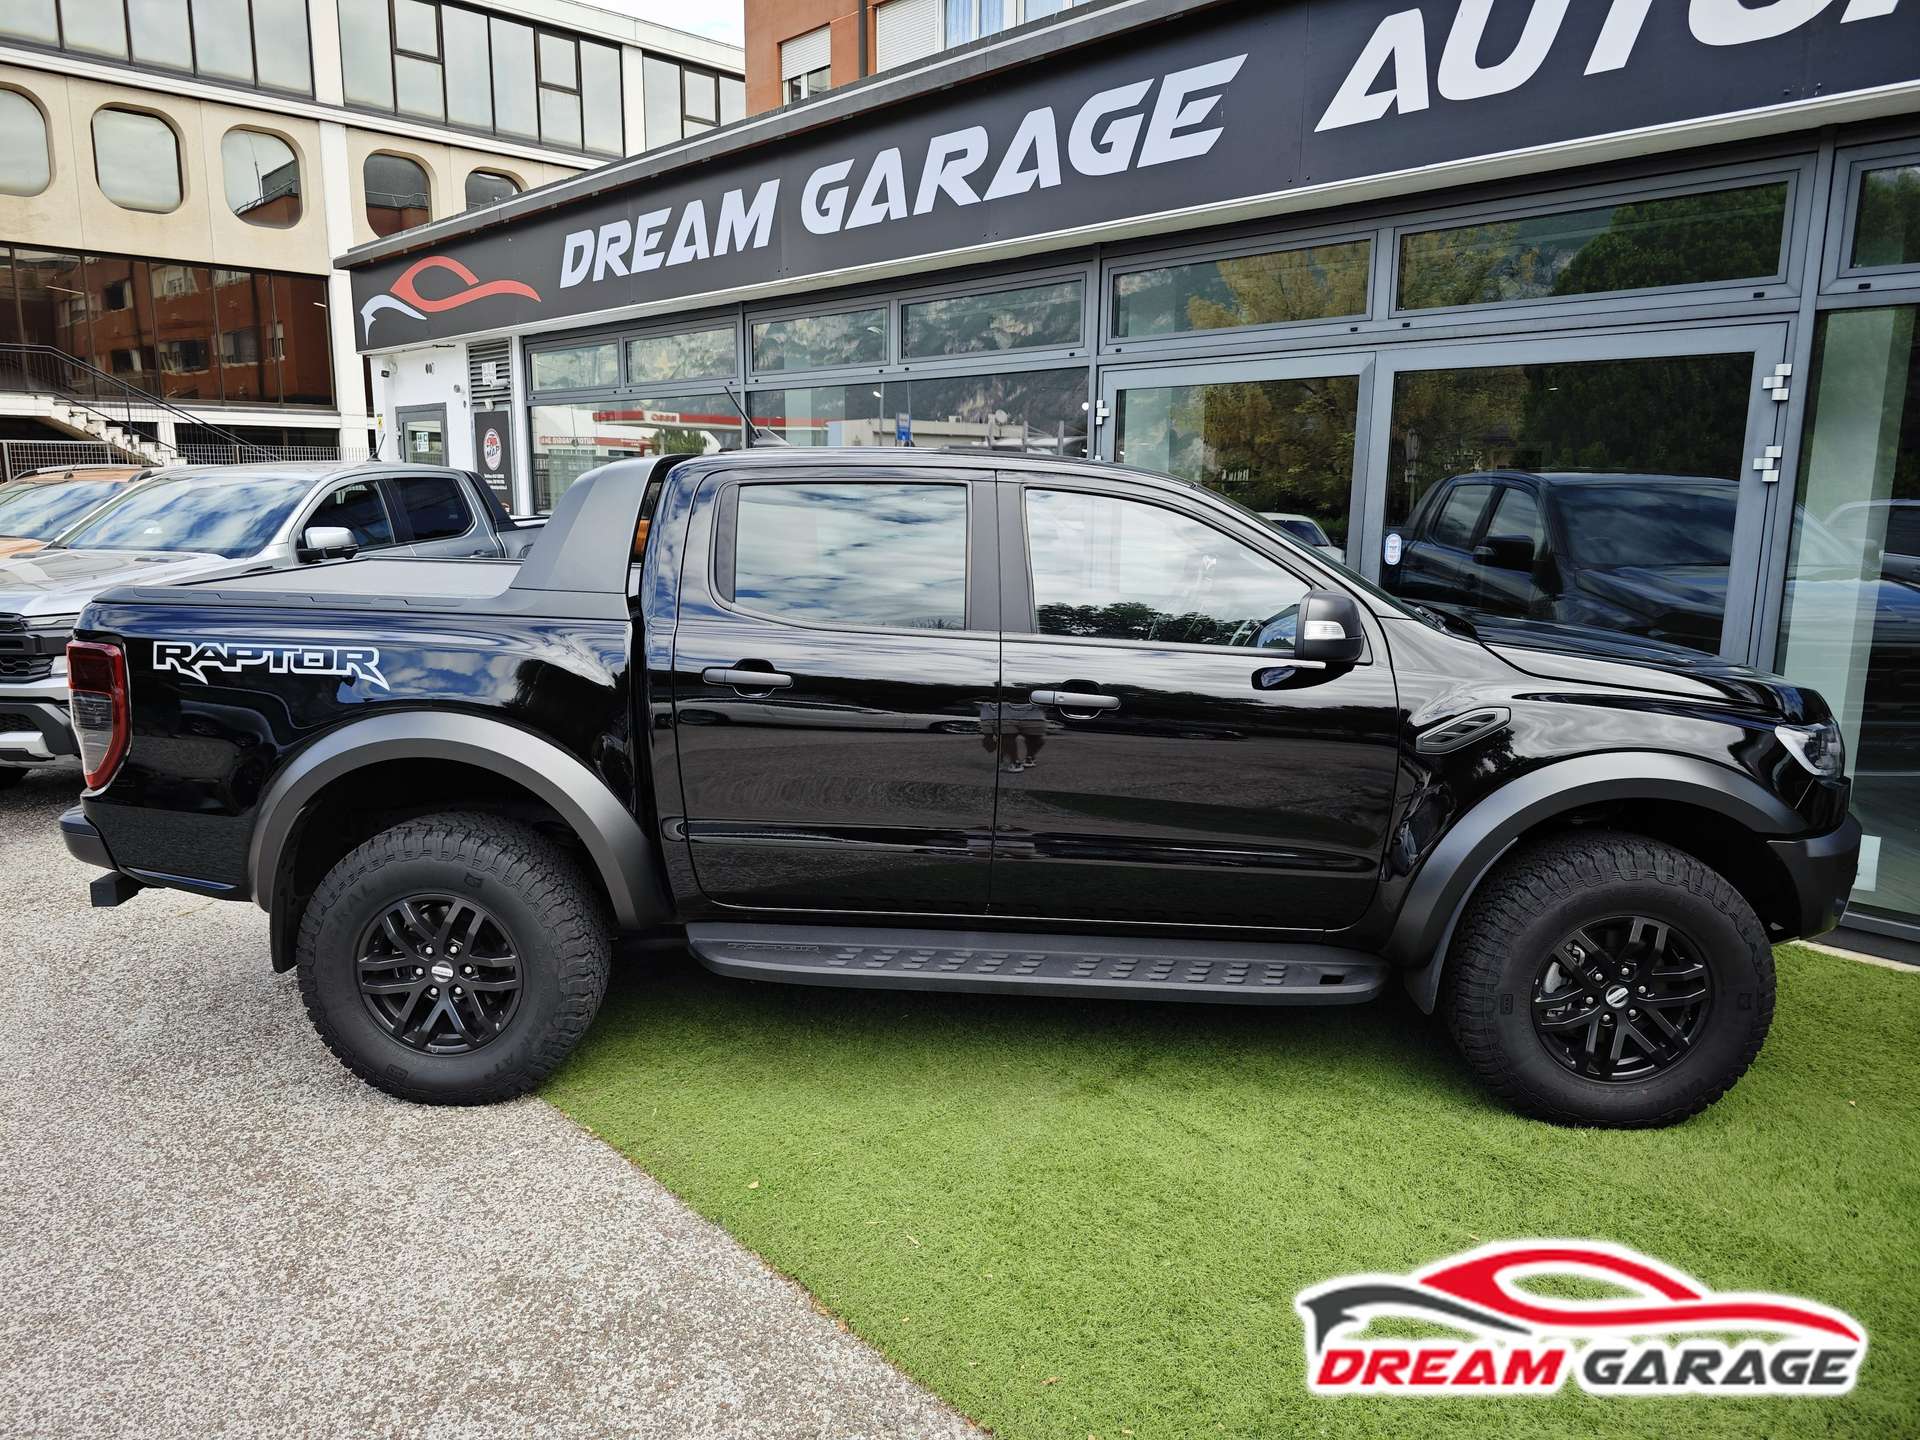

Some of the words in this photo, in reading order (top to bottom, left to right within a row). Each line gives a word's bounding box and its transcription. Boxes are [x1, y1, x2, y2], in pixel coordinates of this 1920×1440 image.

[560, 179, 780, 288] DREAM
[801, 54, 1248, 234] GARAGE
[153, 641, 390, 691] RAPTOR
